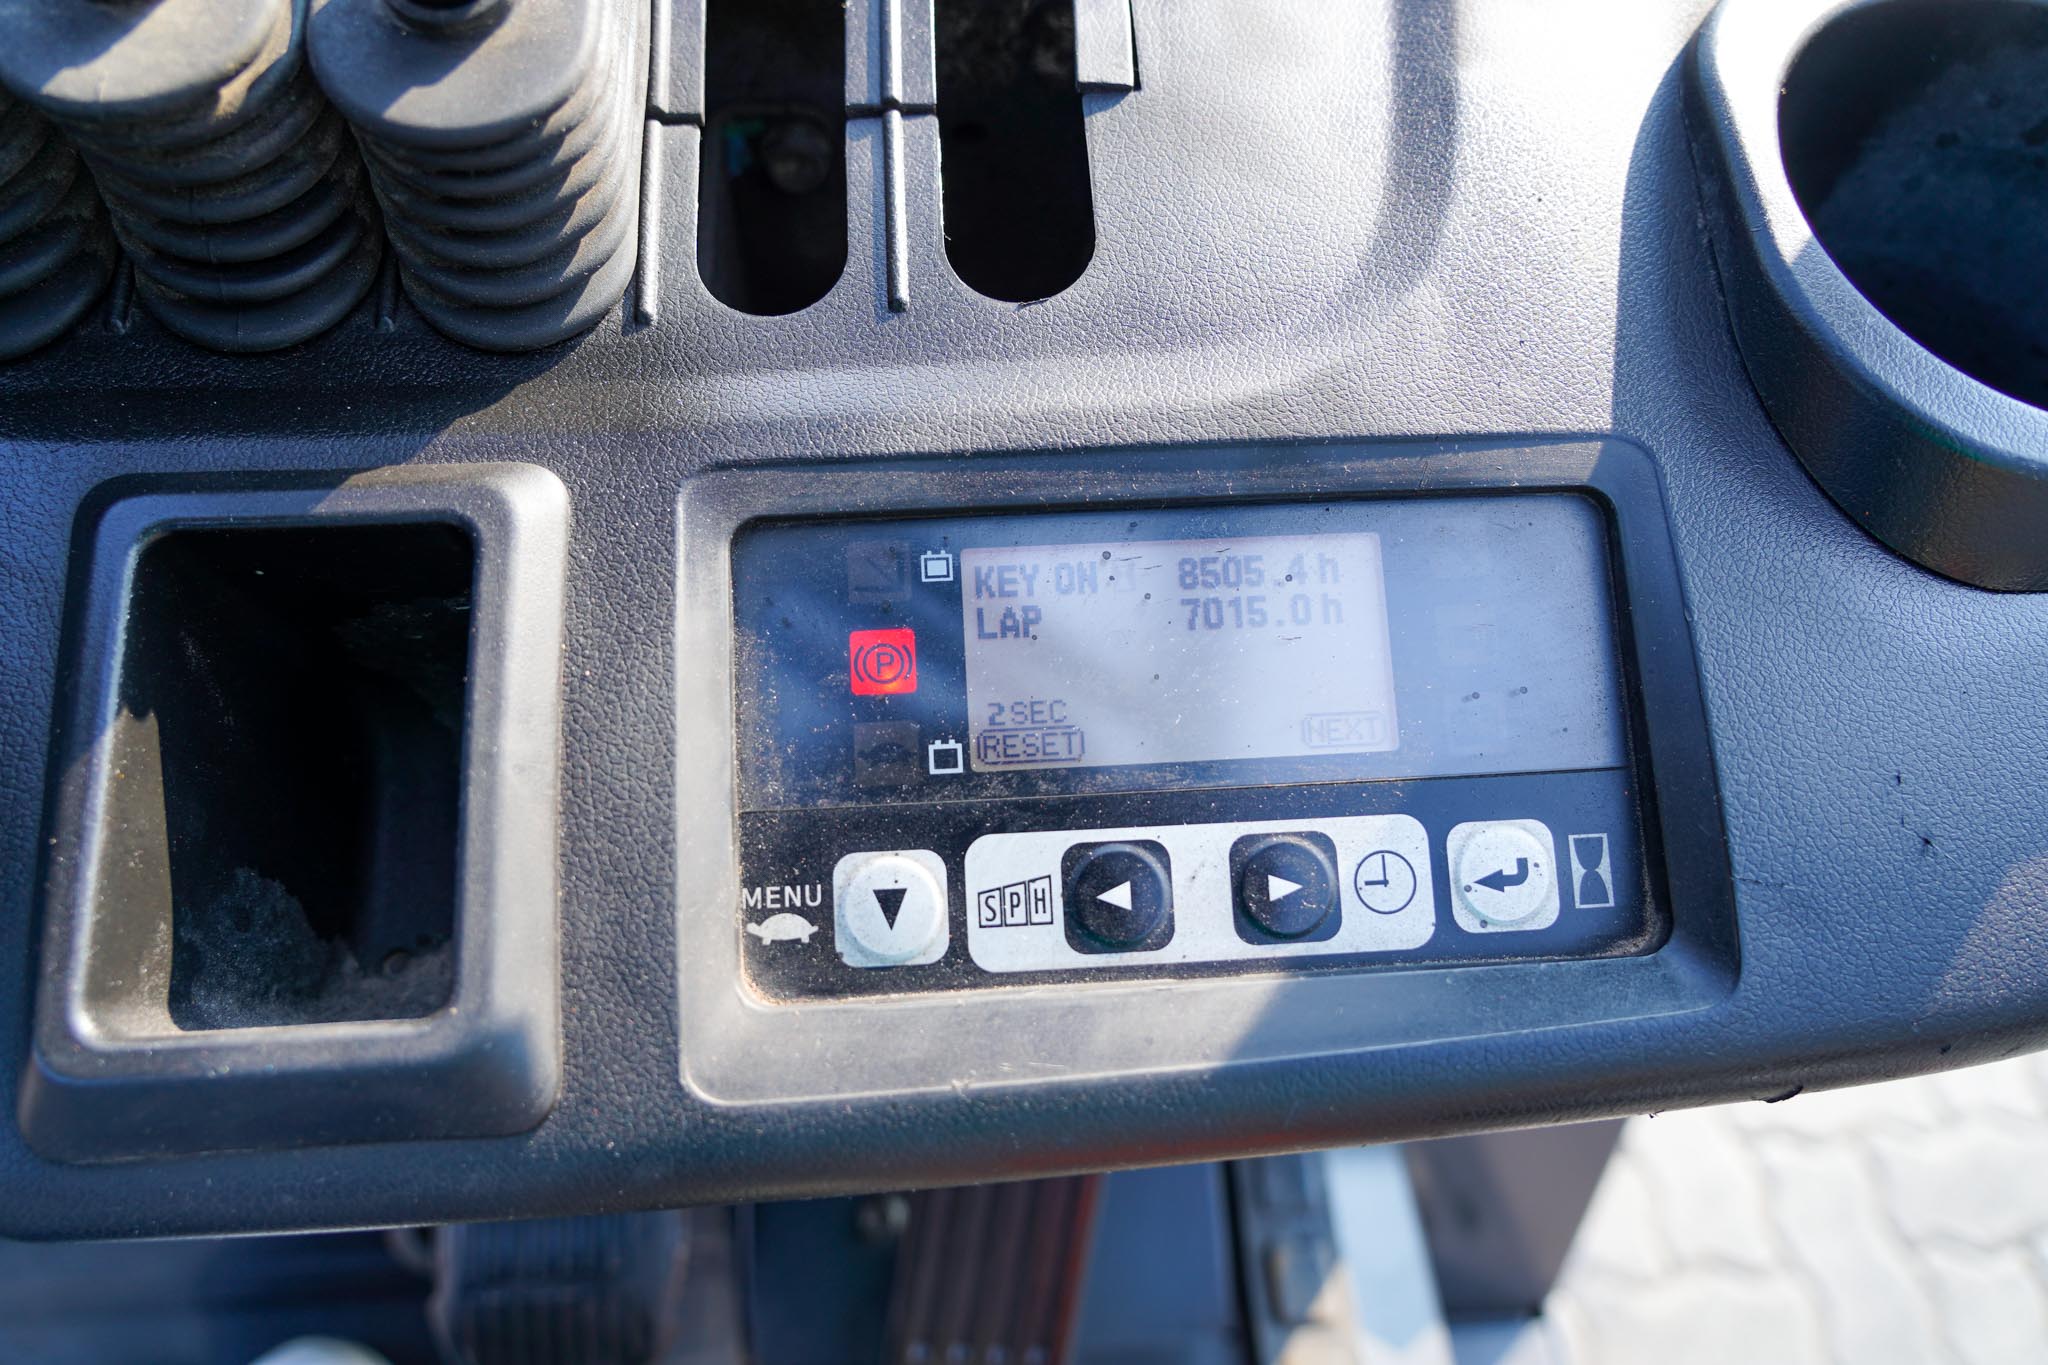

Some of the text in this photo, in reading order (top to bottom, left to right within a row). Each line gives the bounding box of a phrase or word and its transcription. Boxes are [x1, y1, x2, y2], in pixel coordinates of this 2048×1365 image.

[974, 563, 1039, 599] KEY
[1055, 560, 1098, 595] ON
[976, 605, 1042, 640] LAP
[876, 651, 894, 677] P
[1305, 716, 1380, 743] NEXT
[983, 730, 1076, 760] RESET
[742, 884, 823, 910] MENU
